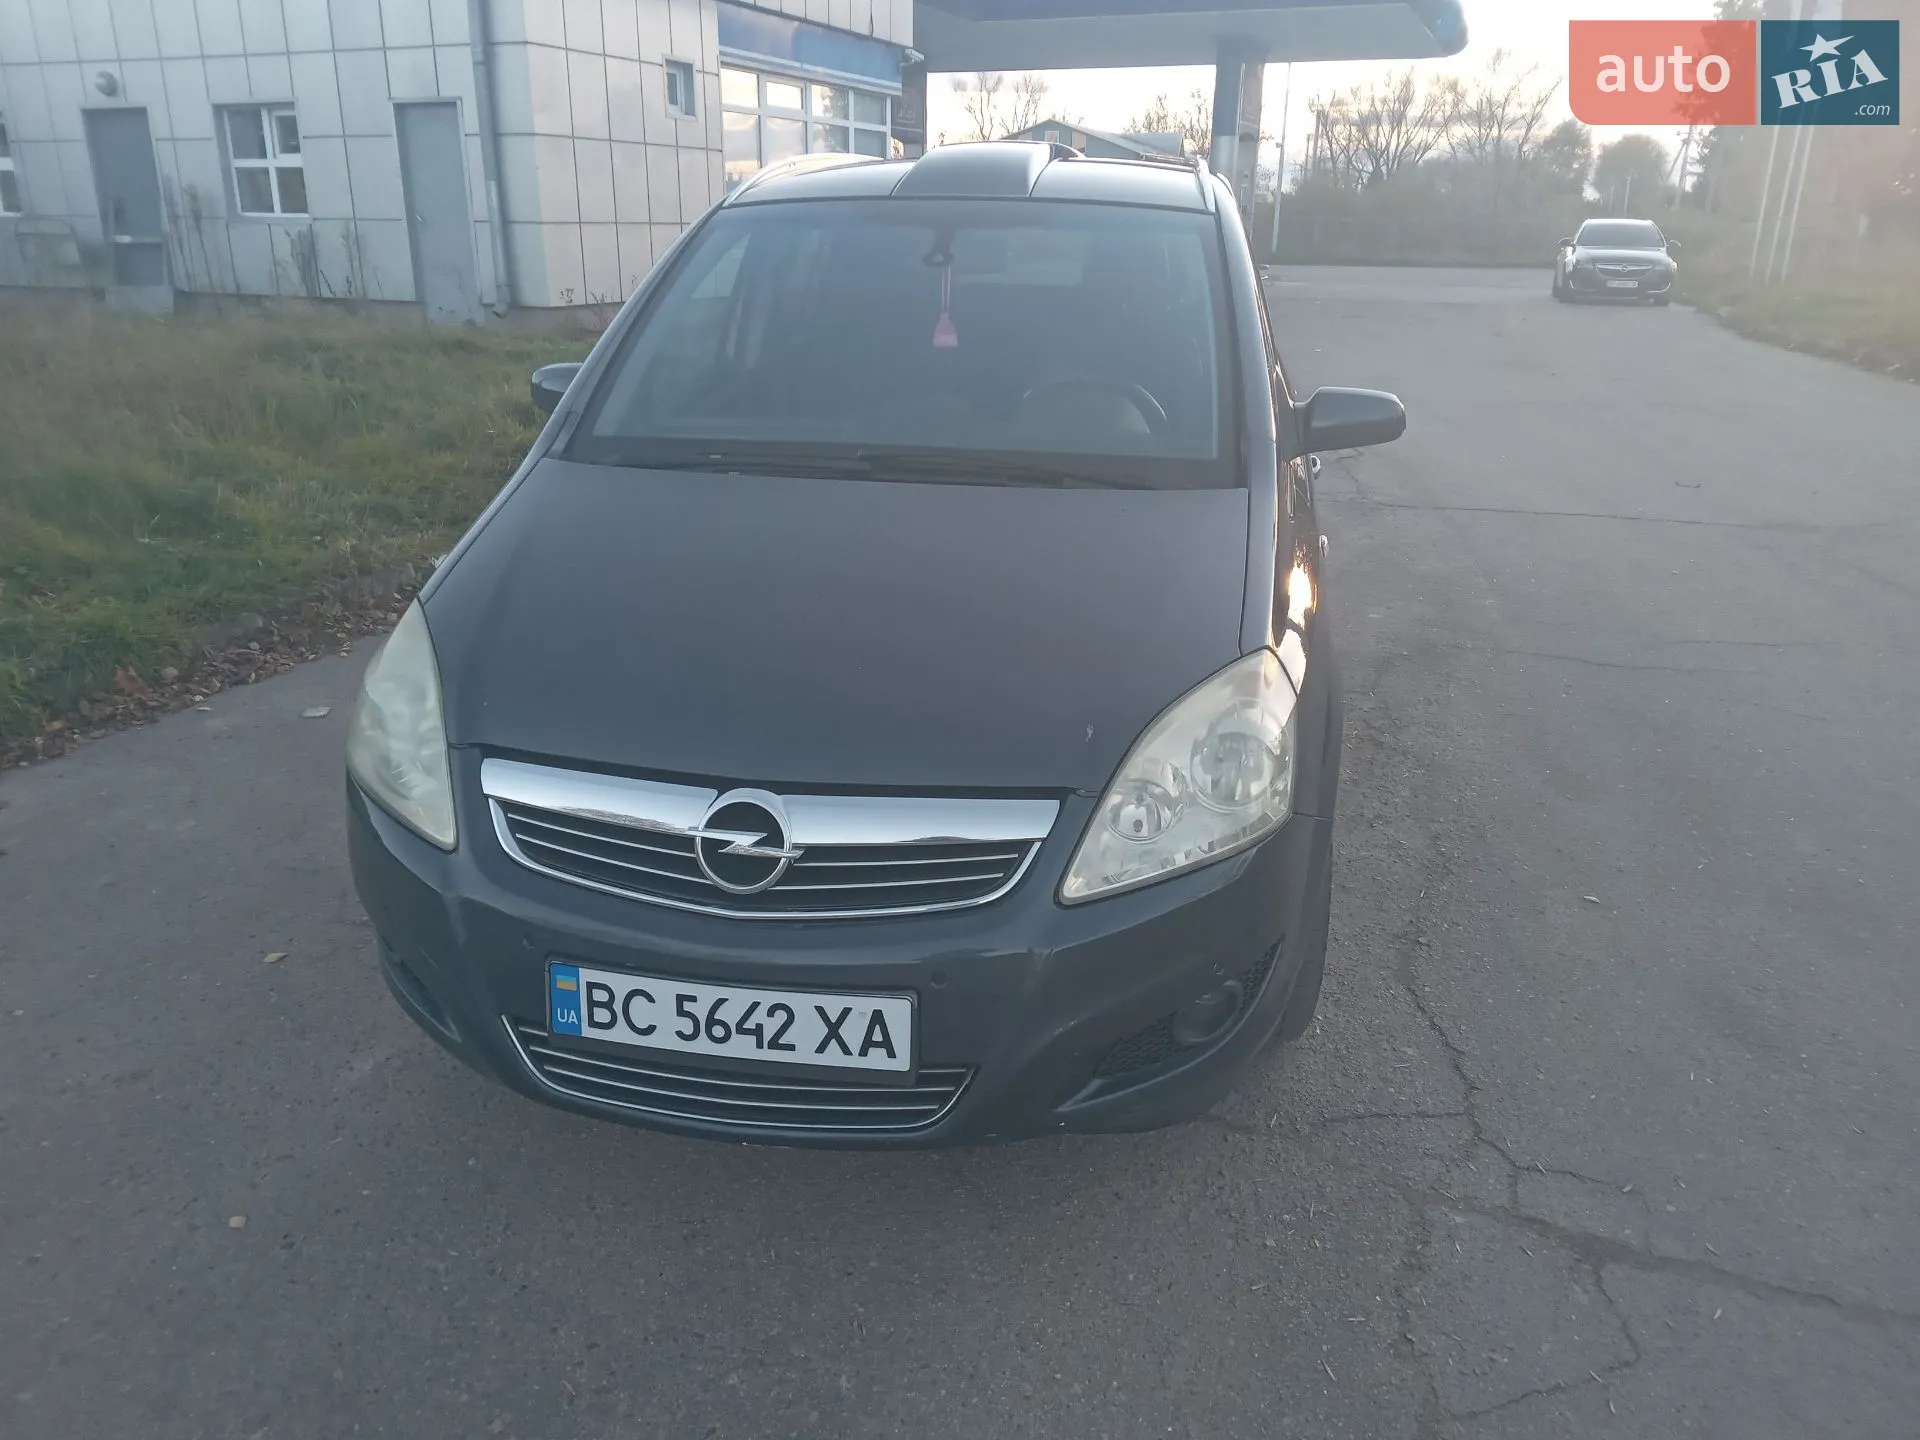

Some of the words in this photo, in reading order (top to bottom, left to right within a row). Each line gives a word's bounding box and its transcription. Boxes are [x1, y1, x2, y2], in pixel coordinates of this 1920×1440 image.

[557, 1008, 579, 1024] UA
[585, 981, 657, 1036] BC
[674, 993, 796, 1052] 5642
[813, 1005, 897, 1058] XA
